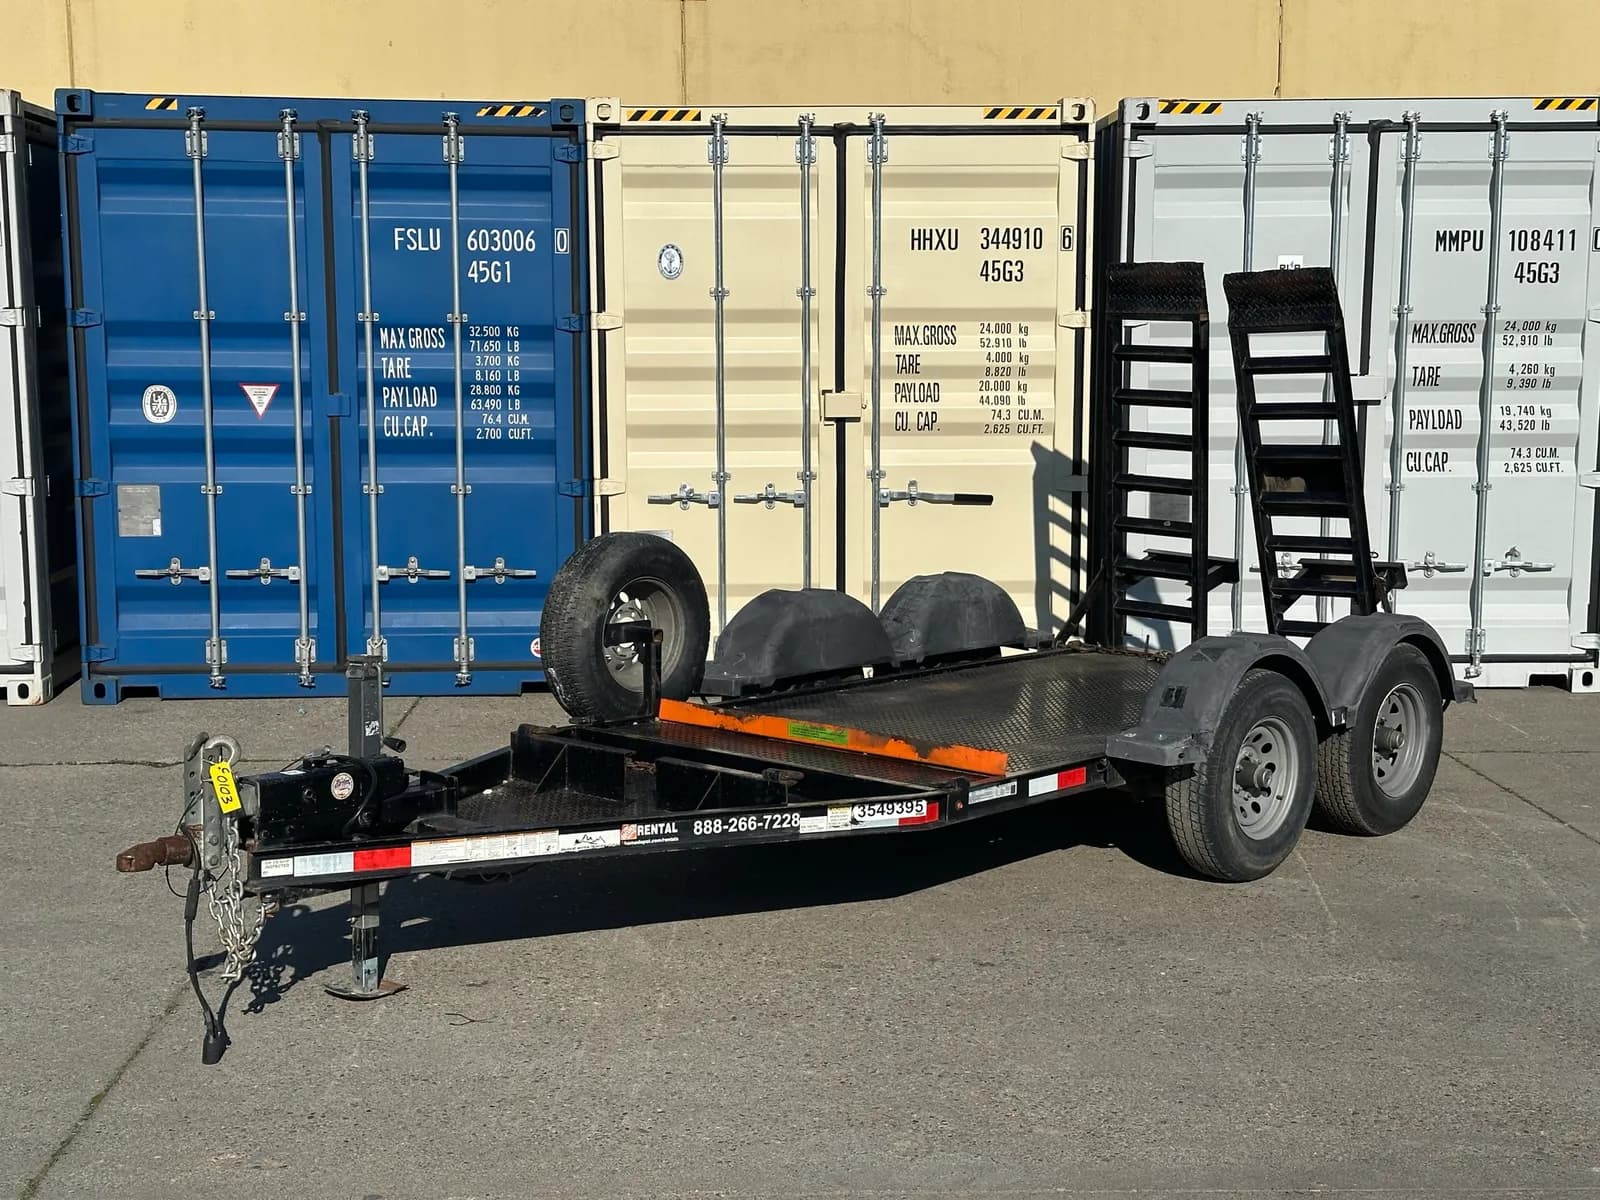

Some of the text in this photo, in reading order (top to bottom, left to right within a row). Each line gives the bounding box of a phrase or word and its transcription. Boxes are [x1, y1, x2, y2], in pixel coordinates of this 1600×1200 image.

[394, 228, 441, 251] FSLU
[467, 229, 536, 252] 603006
[911, 228, 959, 251] HHXU
[980, 227, 1043, 250] 344910
[1435, 230, 1484, 252] MMPU
[1508, 229, 1576, 252] 108411
[467, 260, 512, 283] 45G1
[980, 260, 1024, 282] 45G3
[1514, 262, 1560, 284] 45G3
[469, 326, 519, 337] 32.500 KG
[980, 323, 1029, 336] 24.000 kg
[1544, 321, 1558, 334] kg
[470, 340, 520, 352] 71.650 LB
[980, 338, 1027, 348] 52.910 lb
[1544, 334, 1553, 346] lb
[475, 355, 520, 366] 3.700 KG
[896, 354, 921, 374] TARE
[986, 352, 1029, 365] 4.000 kg
[382, 357, 412, 379] TARE
[985, 366, 1026, 377] 8.820 lb
[1544, 364, 1556, 377] kg
[475, 370, 520, 382] 8.160 LB
[1412, 366, 1441, 387] TARE
[978, 381, 1028, 394] 20.000 kg
[1542, 378, 1552, 388] lb
[470, 384, 520, 396] 28.800 KG
[894, 382, 940, 403] PAYLOAD
[383, 386, 438, 408] PAYLOAD
[978, 396, 1026, 406] 44.090 lb
[470, 399, 520, 411] 63.490 LB
[991, 410, 1011, 421] 74.3
[1540, 406, 1552, 418] kg
[482, 414, 502, 425] 76.4
[1409, 410, 1462, 430] PAYLOAD
[1541, 420, 1550, 431] lb
[476, 428, 502, 440] 2.700
[984, 424, 1010, 434] 2.625
[1510, 448, 1532, 459] 74.3
[857, 800, 924, 818] 3549395
[637, 822, 678, 836] RENTAL
[693, 812, 800, 835] 888-266-7228
